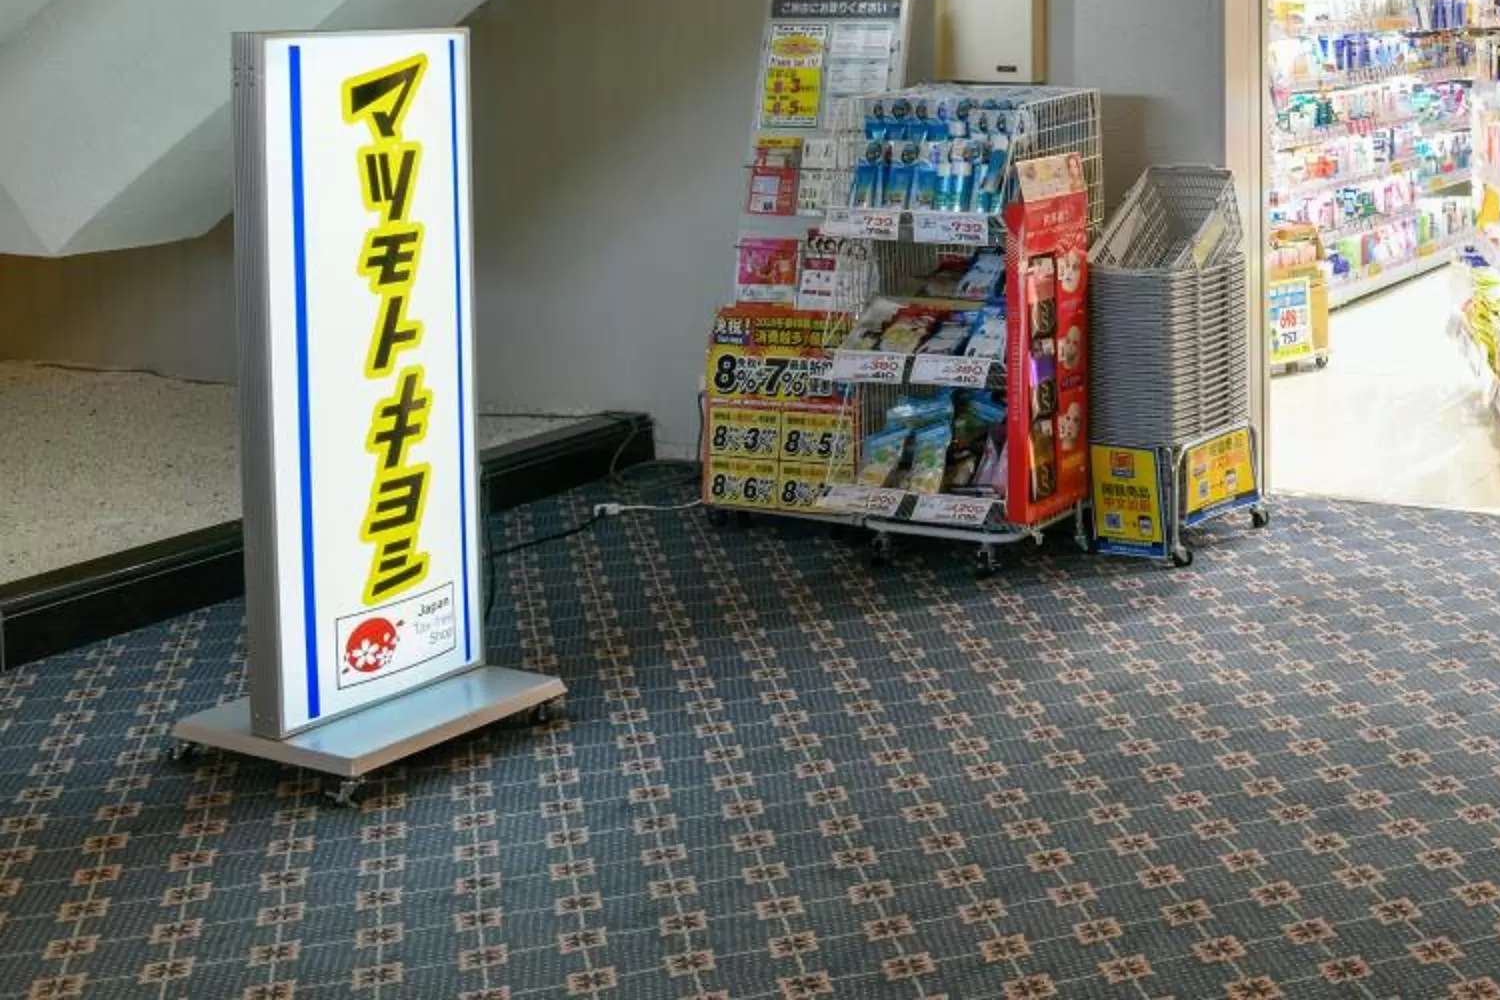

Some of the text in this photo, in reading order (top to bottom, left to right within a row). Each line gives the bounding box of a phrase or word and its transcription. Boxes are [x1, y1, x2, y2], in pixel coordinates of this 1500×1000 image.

[347, 57, 428, 600] マツモトキヨシ
